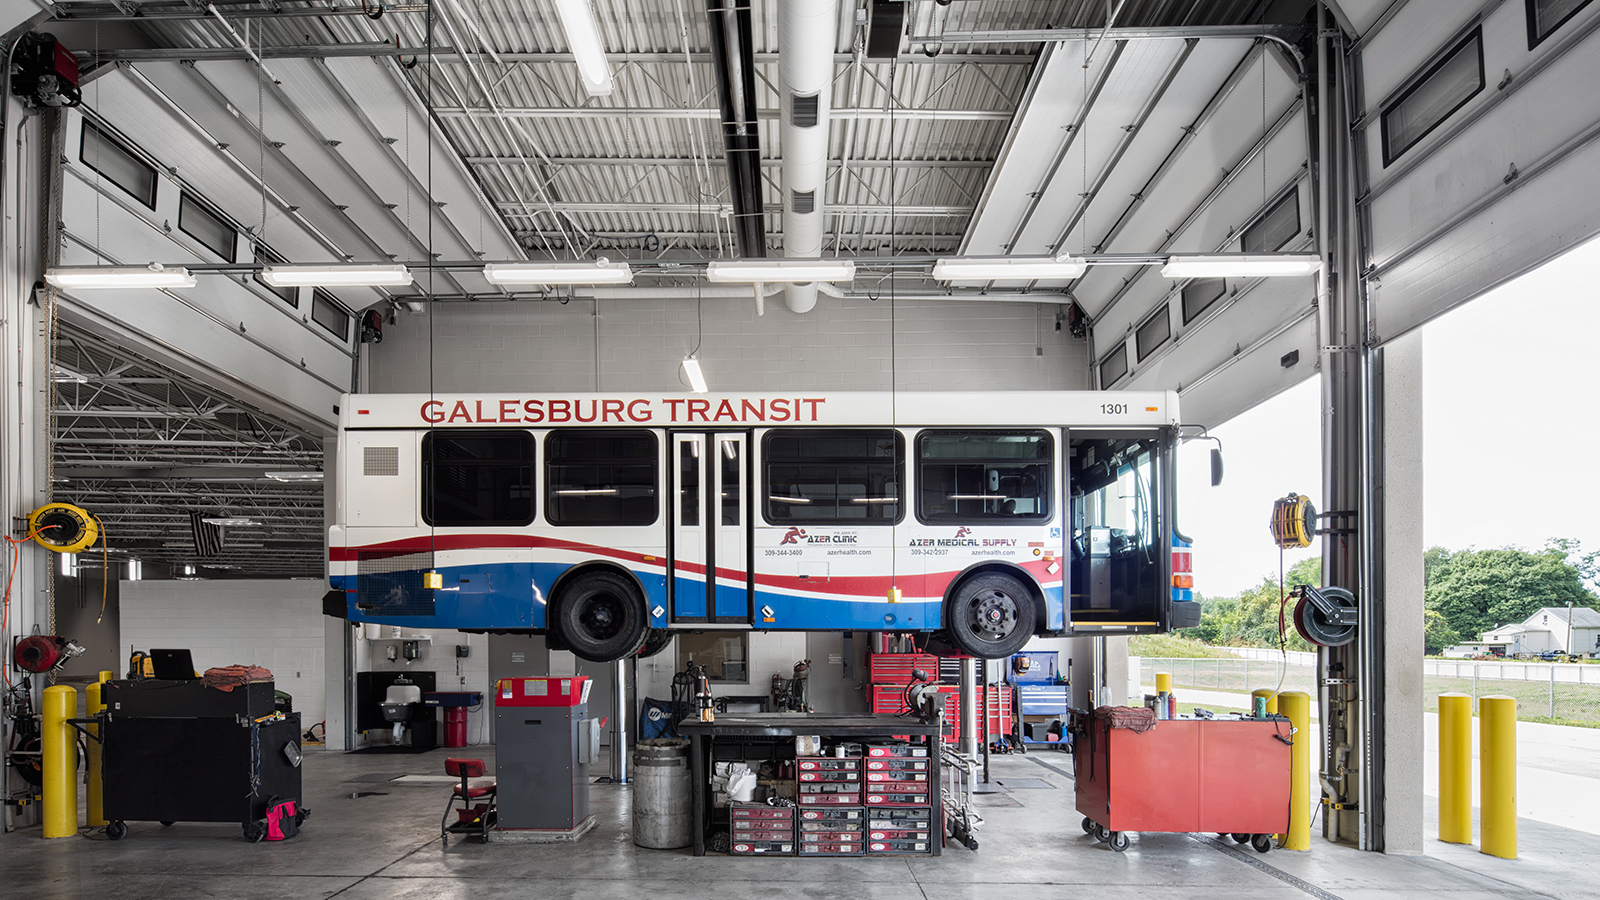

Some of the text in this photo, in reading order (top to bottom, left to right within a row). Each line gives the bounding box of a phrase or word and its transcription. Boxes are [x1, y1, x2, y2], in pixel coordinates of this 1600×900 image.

[421, 398, 826, 423] GALESBURG TRANSIT
[1100, 403, 1128, 414] 1301
[807, 535, 857, 543] AZER CLINIC
[909, 539, 1017, 547] AZER MEDICAL SUPPLY
[764, 549, 803, 557] 309-344-3400
[827, 548, 871, 556] azerhealth.com
[971, 548, 1015, 556] azerhealth.com
